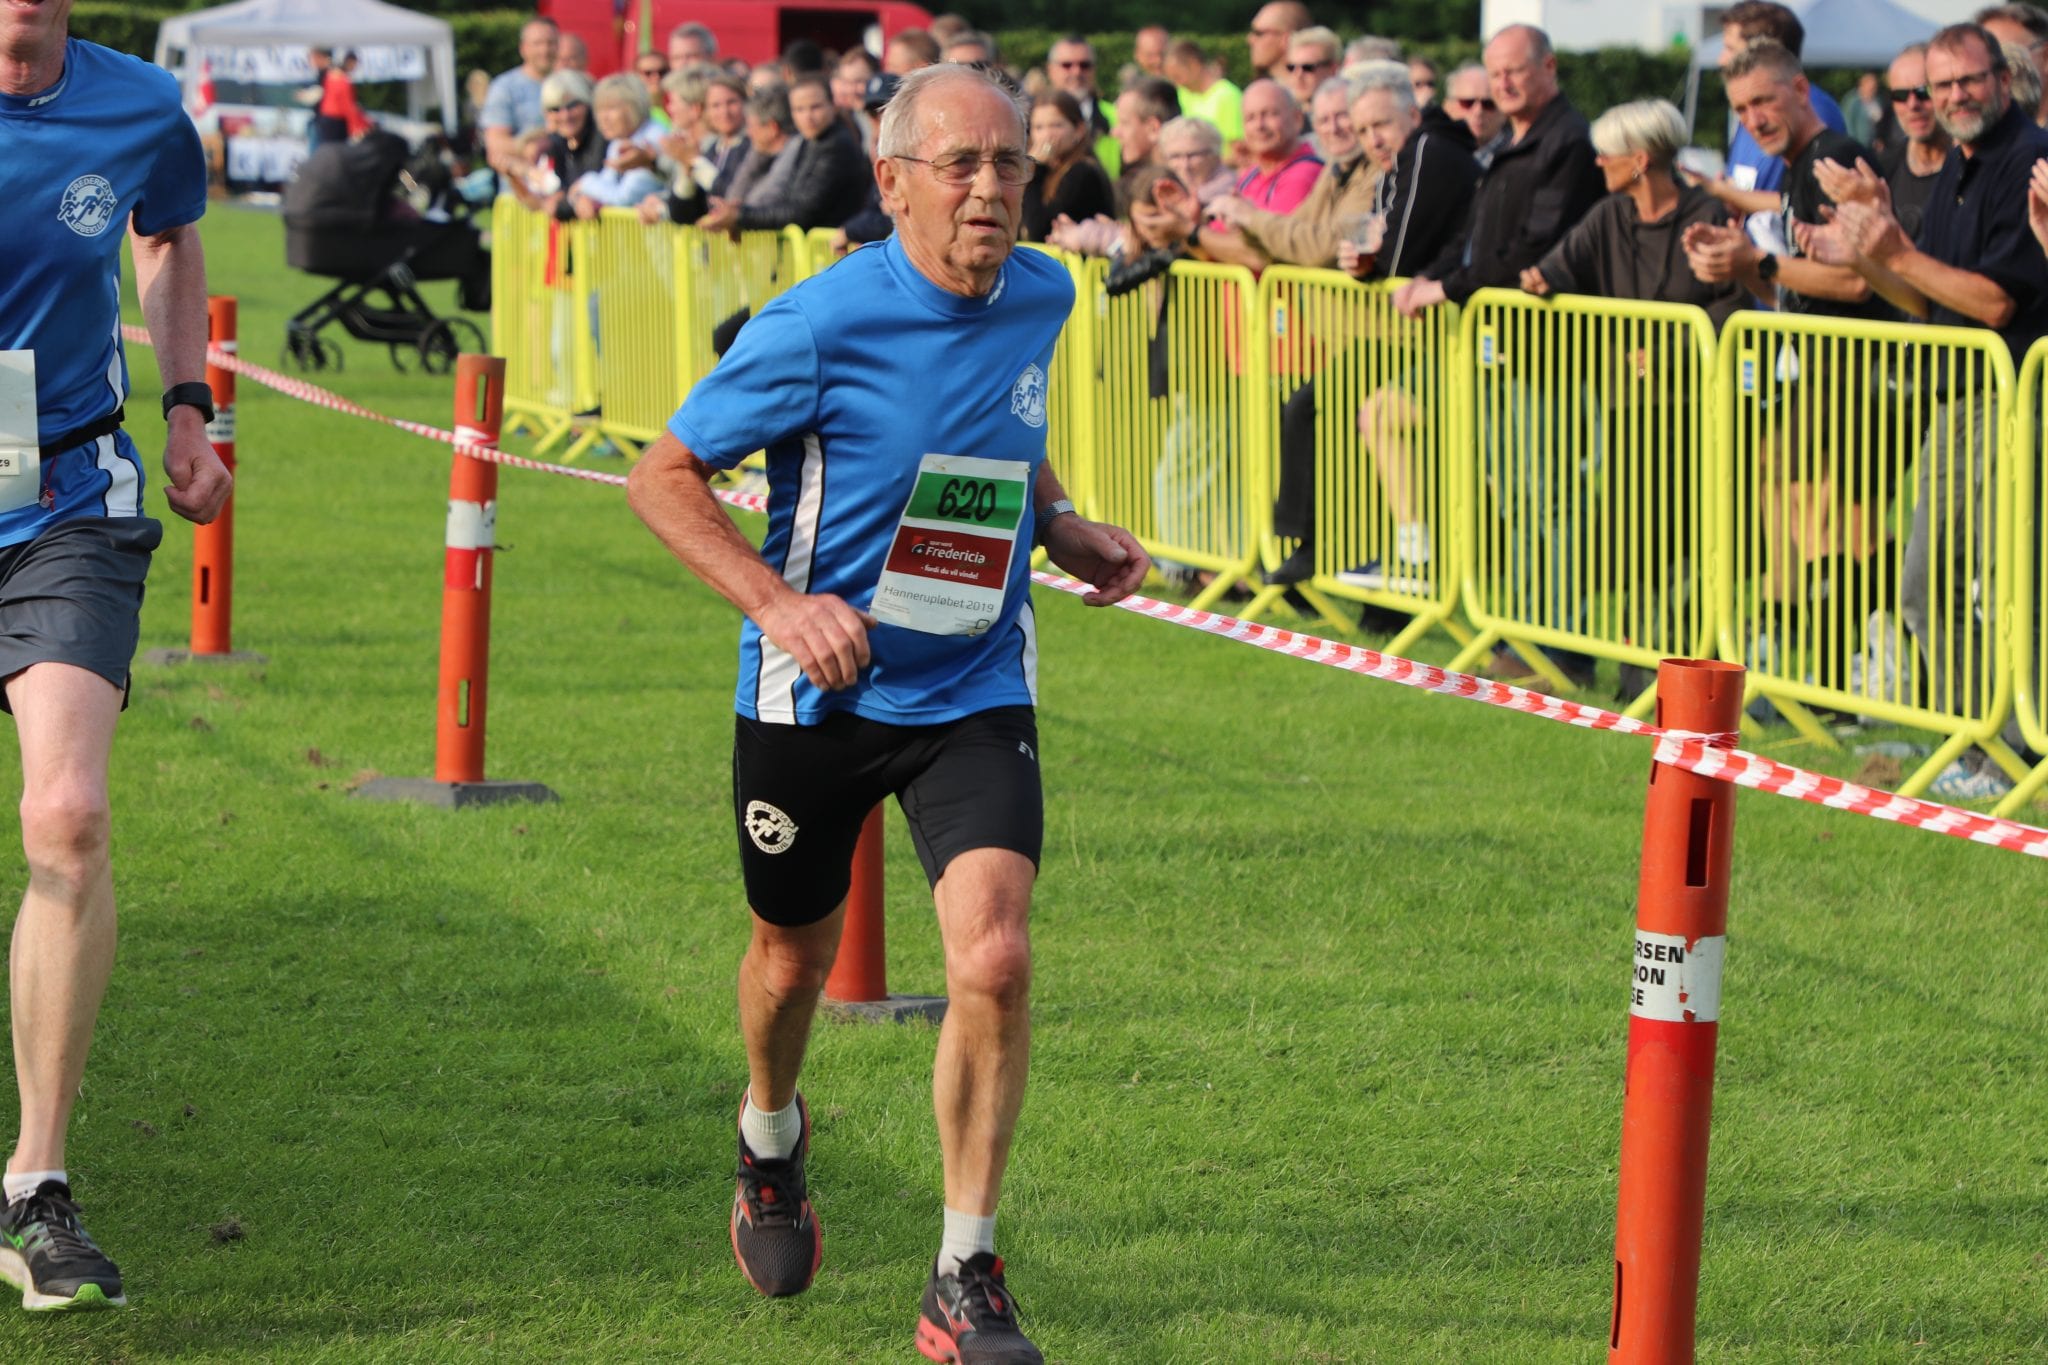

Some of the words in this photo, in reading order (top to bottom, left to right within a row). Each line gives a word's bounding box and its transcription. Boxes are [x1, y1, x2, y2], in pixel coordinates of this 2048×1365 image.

[937, 478, 997, 522] 620
[925, 546, 986, 564] Fredericia
[884, 585, 964, 608] Hannerupløbet
[966, 600, 994, 612] 2019
[1634, 939, 1685, 964] RSEN
